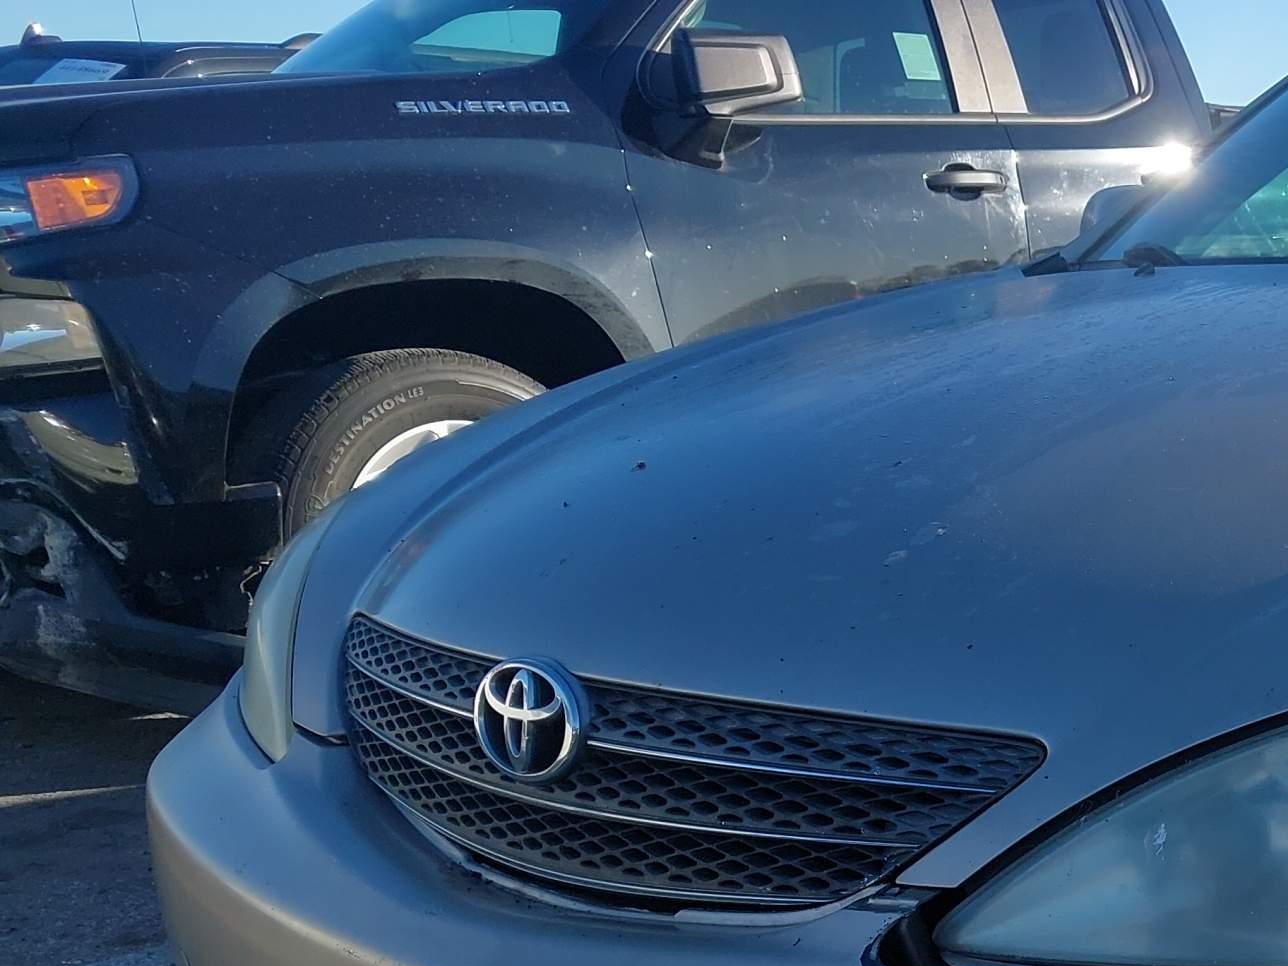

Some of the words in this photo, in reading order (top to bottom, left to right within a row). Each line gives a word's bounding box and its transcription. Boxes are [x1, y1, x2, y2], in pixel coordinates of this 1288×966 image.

[396, 99, 571, 114] SILVERADO
[325, 393, 407, 475] DESTINATION
[407, 386, 425, 399] LE3
